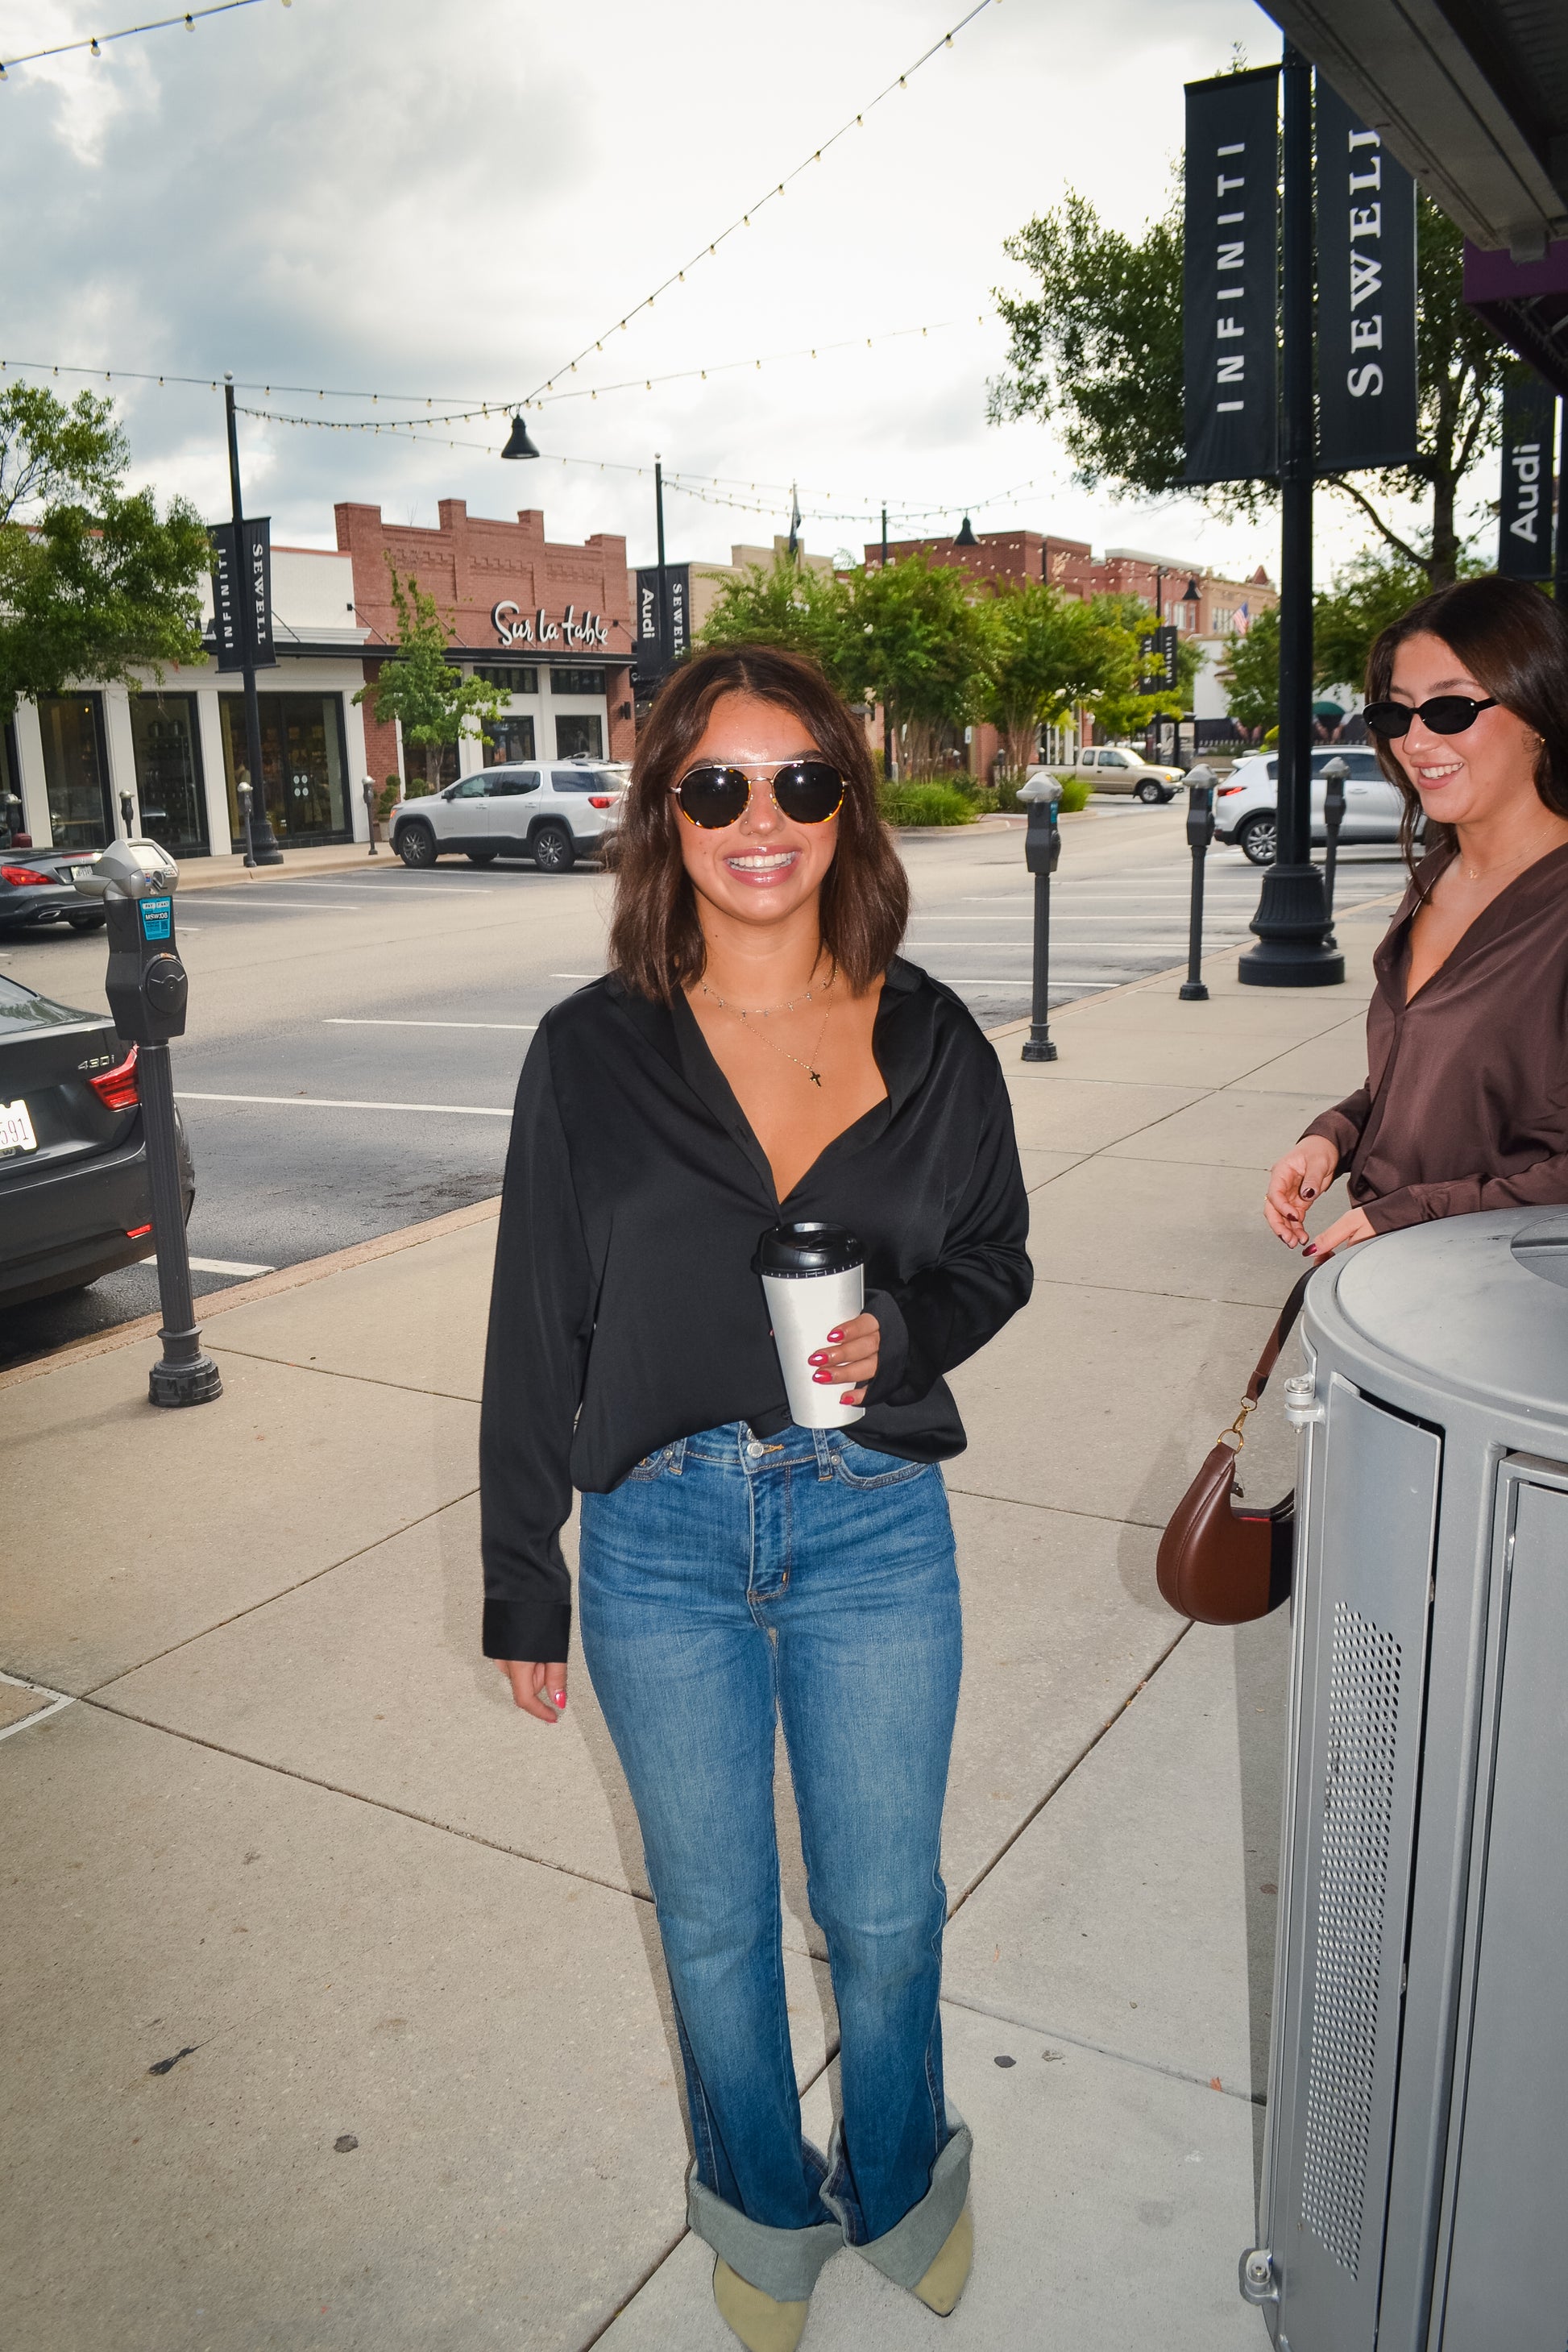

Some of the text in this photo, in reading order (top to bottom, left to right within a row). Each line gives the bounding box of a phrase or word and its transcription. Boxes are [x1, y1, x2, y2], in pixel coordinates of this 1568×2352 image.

[1217, 143, 1245, 413] INFINITI
[1509, 443, 1541, 544] Audi
[218, 548, 234, 649] INFINITI
[252, 543, 266, 645] SEWELL
[491, 599, 608, 646] Sur la table
[642, 587, 656, 639] Audi
[77, 1054, 115, 1070] 430i
